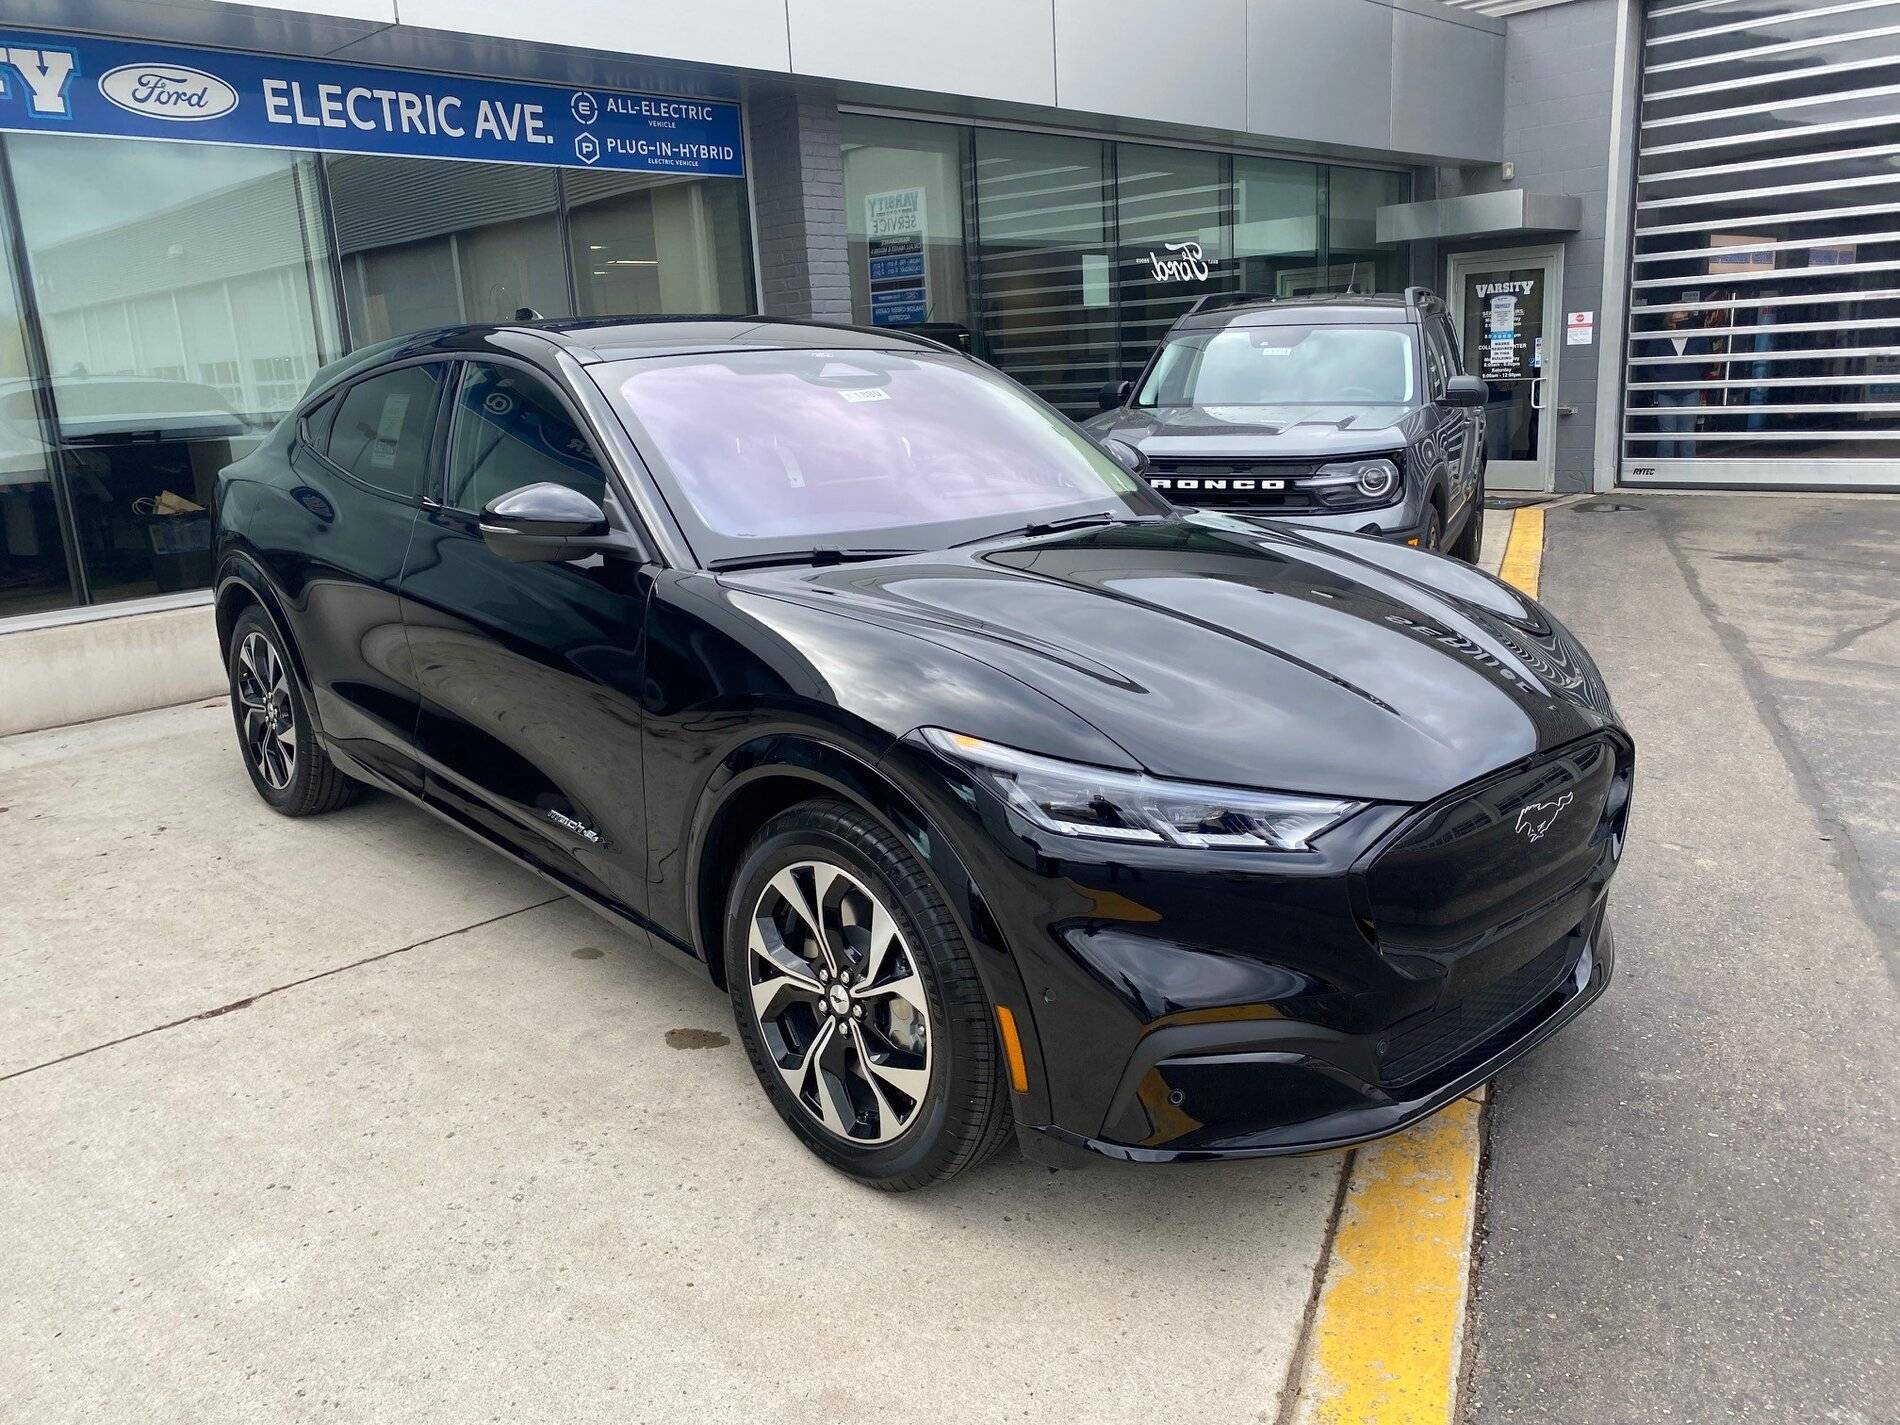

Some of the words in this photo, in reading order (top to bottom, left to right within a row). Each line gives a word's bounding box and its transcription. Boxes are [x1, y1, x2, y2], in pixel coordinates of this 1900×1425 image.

[131, 73, 209, 108] Ford
[262, 78, 466, 138] ELECTRIC
[474, 100, 554, 144] AVE.
[606, 98, 713, 121] ALL-ELECTRIC
[648, 120, 676, 129] VEHICLE
[606, 138, 734, 161] PLUG-IN-HYBRID
[647, 158, 673, 166] ELECTRIC
[675, 159, 699, 167] VEHICLE
[1475, 281, 1534, 298] VARSITY
[1150, 479, 1285, 489] RONCO
